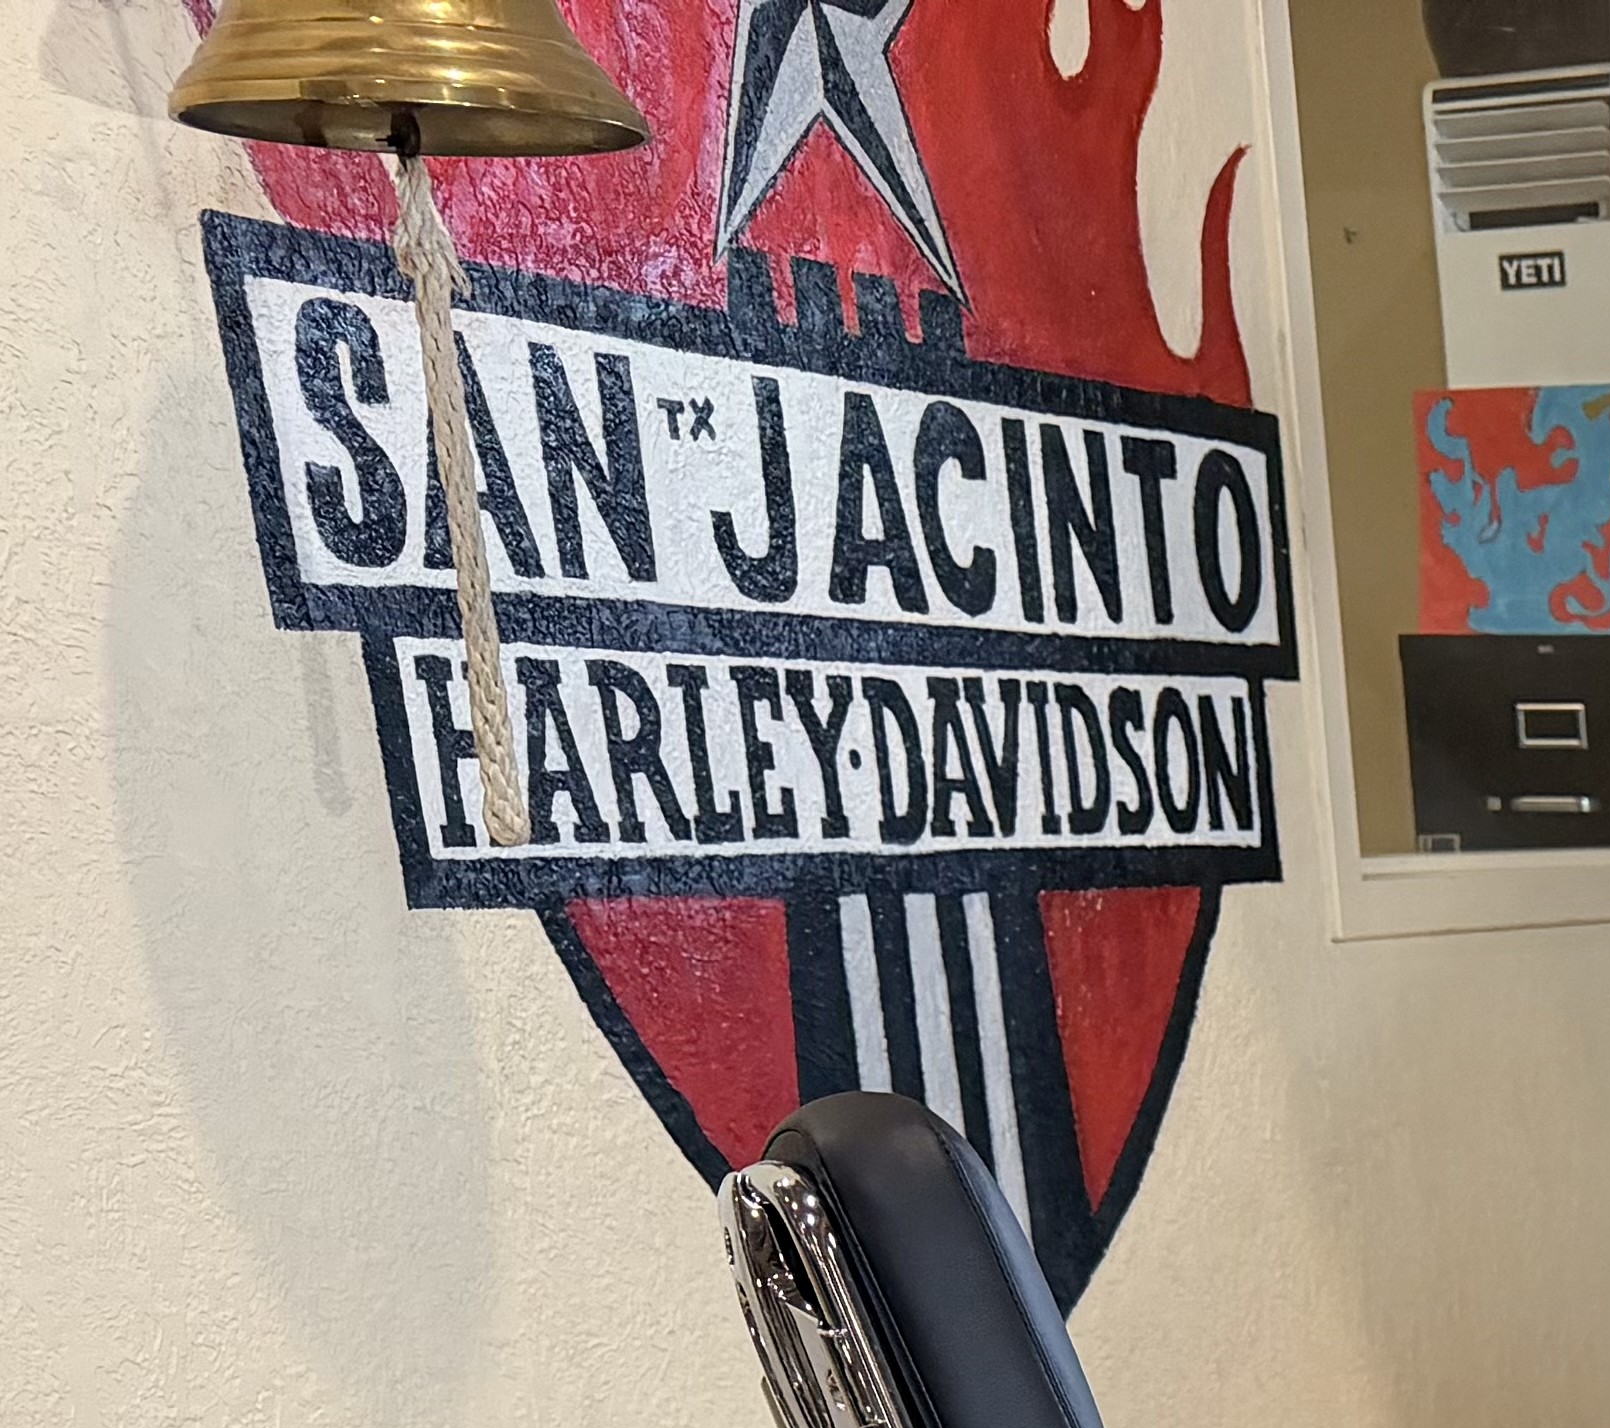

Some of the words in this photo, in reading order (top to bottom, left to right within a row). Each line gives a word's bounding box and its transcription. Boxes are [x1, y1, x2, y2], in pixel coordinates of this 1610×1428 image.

[1502, 256, 1562, 286] YETI
[293, 298, 658, 584] SAN
[656, 398, 718, 443] TX
[709, 377, 1264, 634] JACINTO
